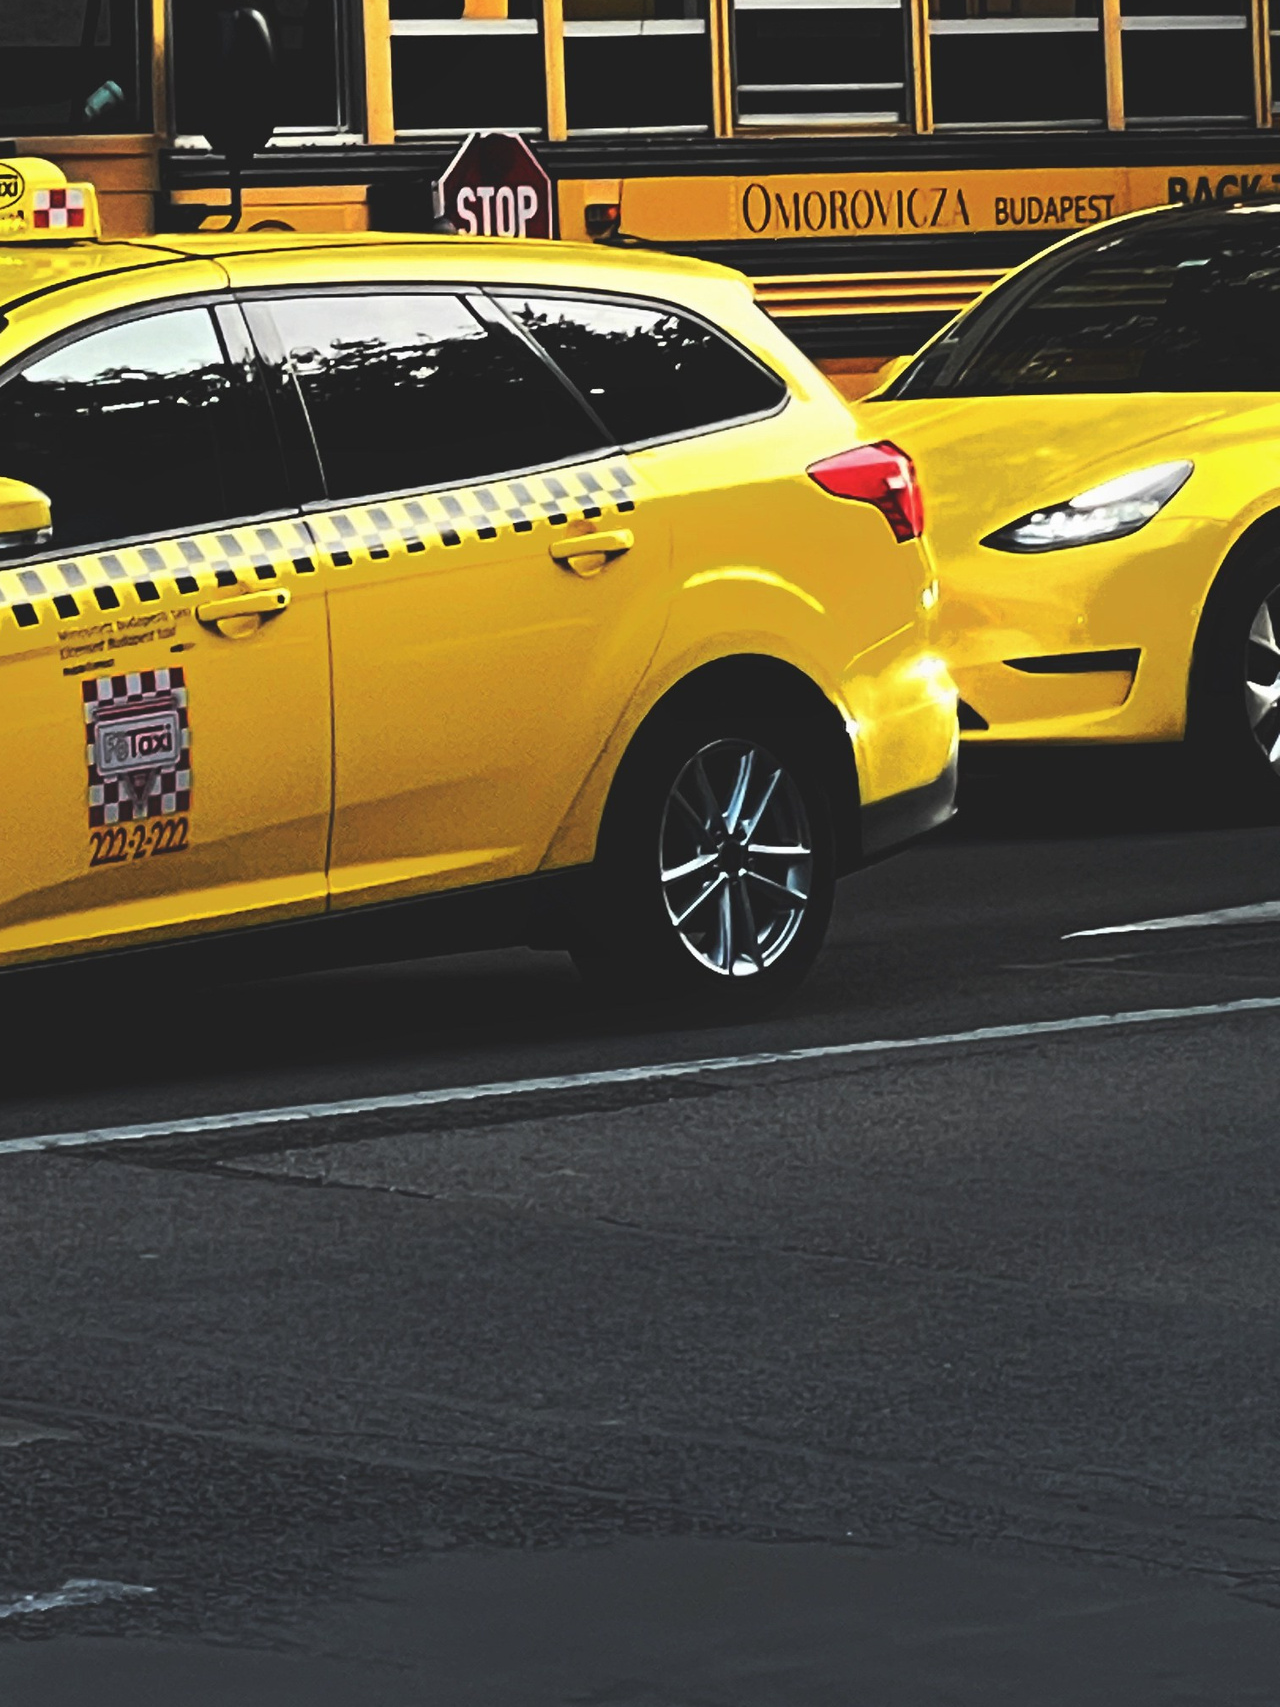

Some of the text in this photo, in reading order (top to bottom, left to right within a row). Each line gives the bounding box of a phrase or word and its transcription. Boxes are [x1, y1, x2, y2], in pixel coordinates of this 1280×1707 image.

[456, 185, 538, 239] STOP
[742, 182, 971, 233] OMOROVICZA
[994, 194, 1116, 226] BUDAPEST
